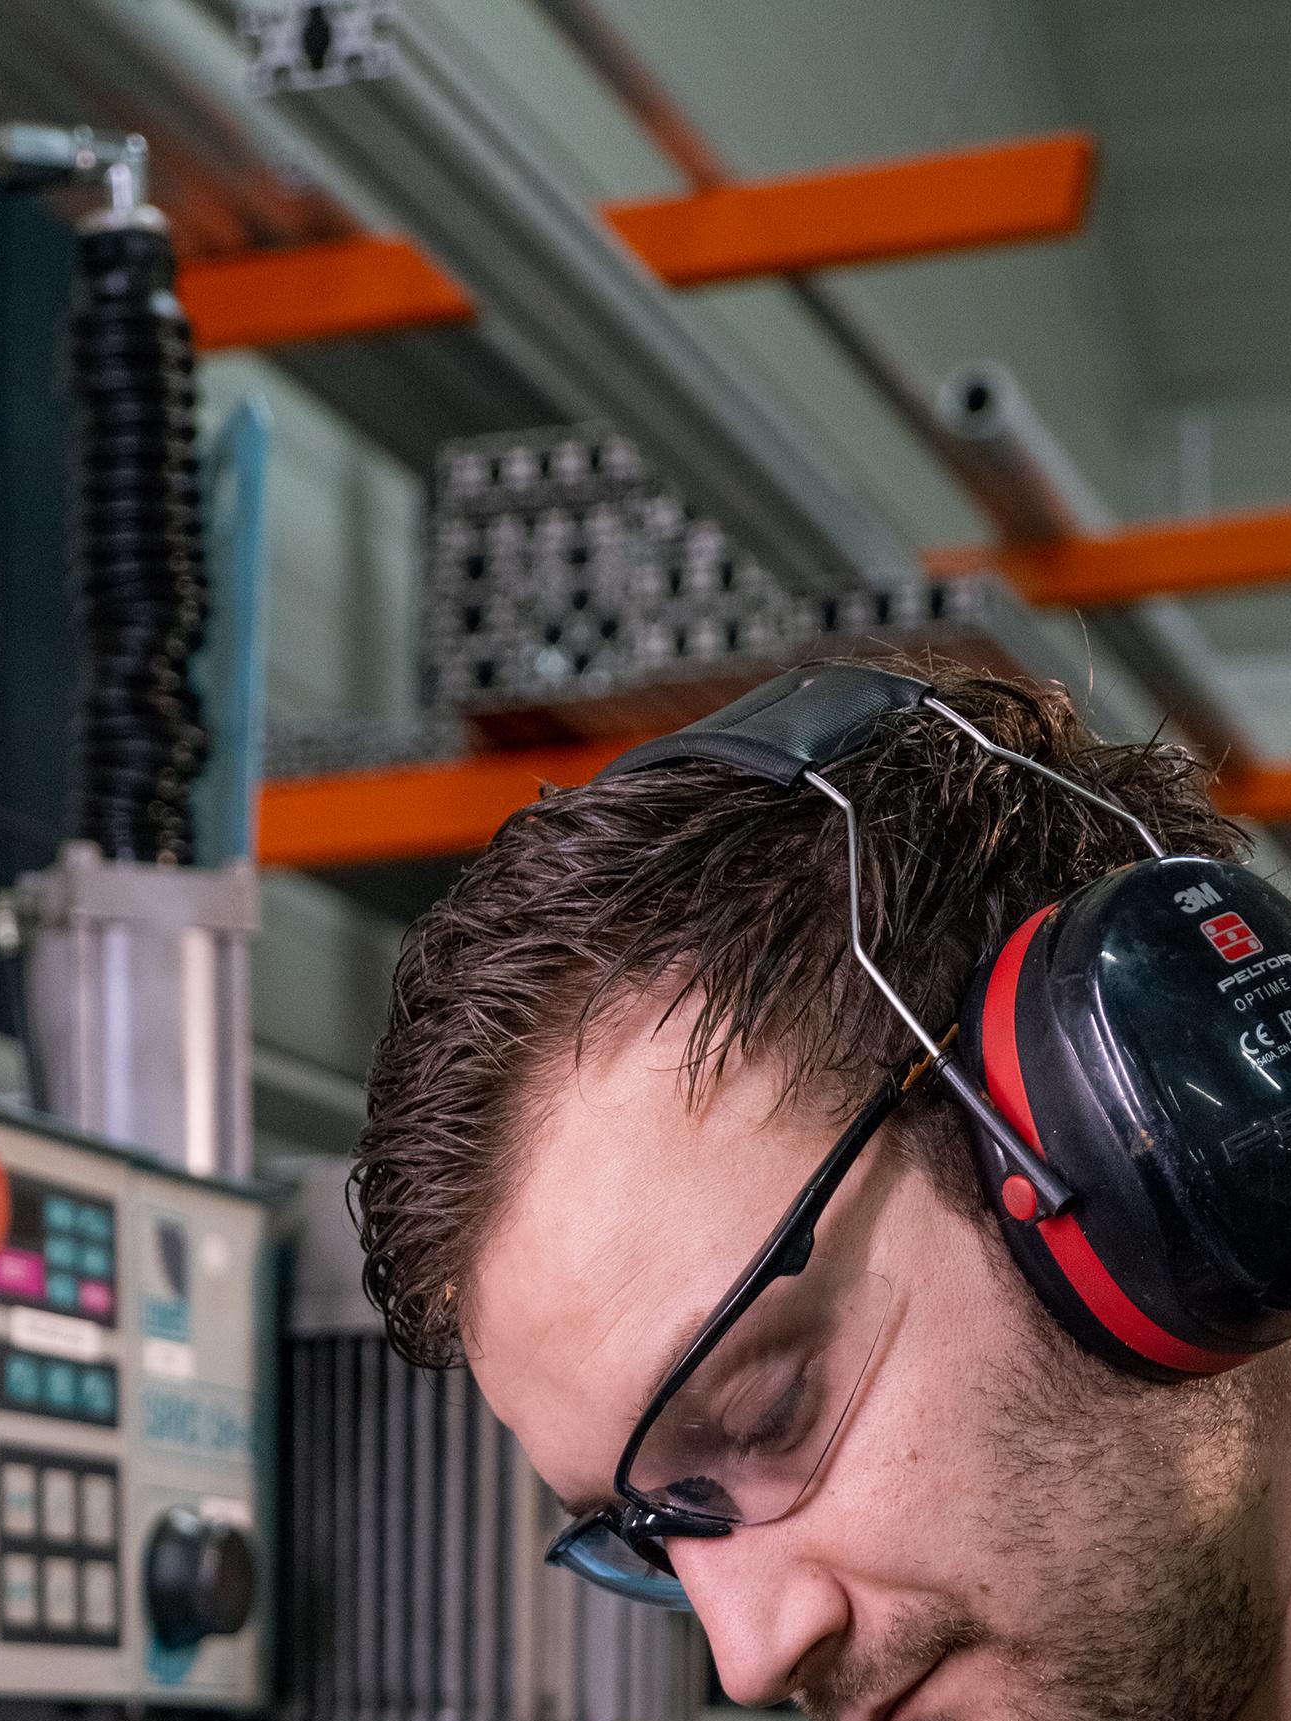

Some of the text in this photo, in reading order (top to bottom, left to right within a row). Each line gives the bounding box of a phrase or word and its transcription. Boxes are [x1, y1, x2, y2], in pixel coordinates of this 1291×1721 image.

[1173, 881, 1224, 914] 3M
[1234, 977, 1291, 1012] OPTIME
[1239, 1022, 1275, 1055] CE
[1277, 1042, 1291, 1056] EN
